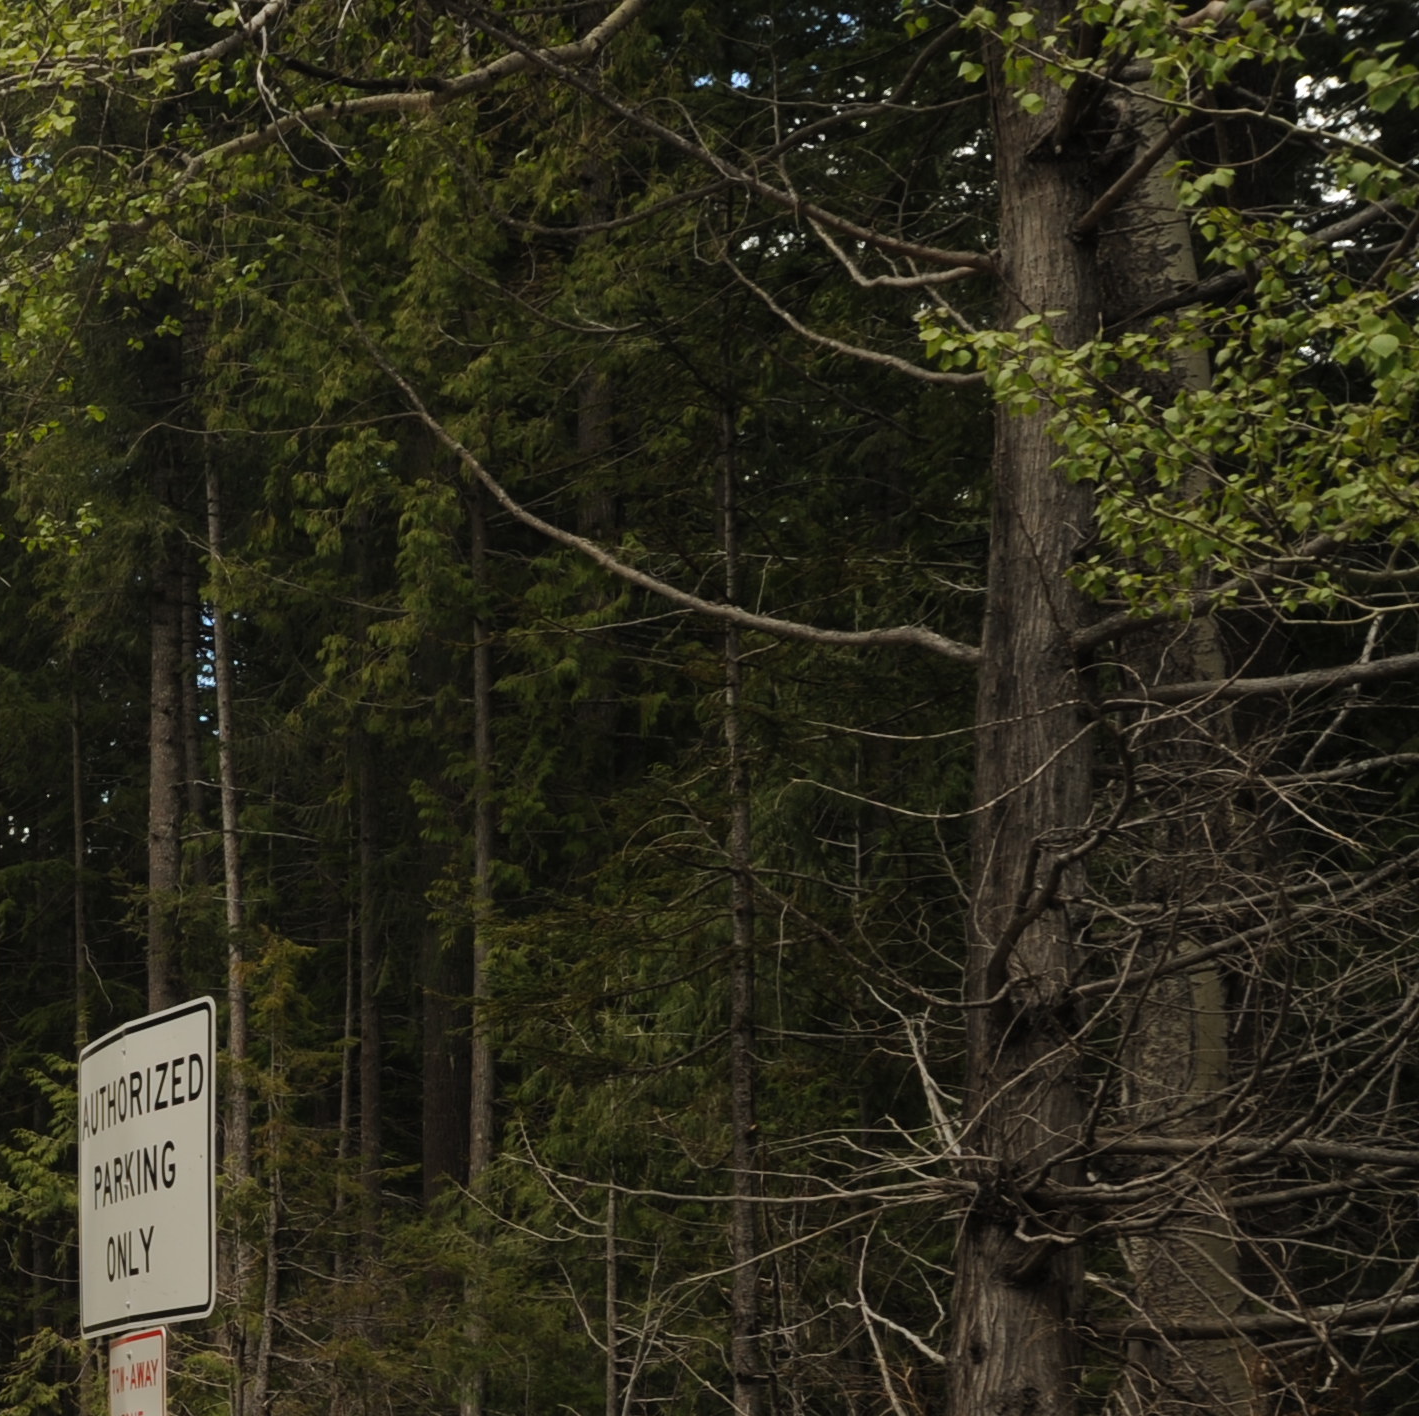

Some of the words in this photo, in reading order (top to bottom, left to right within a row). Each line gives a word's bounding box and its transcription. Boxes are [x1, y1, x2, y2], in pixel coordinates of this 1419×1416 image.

[82, 1053, 204, 1141] AUTHORIZED
[94, 1140, 176, 1211] PARKING
[106, 1225, 155, 1283] ONLY
[112, 1359, 159, 1395] TOW-AWAY
